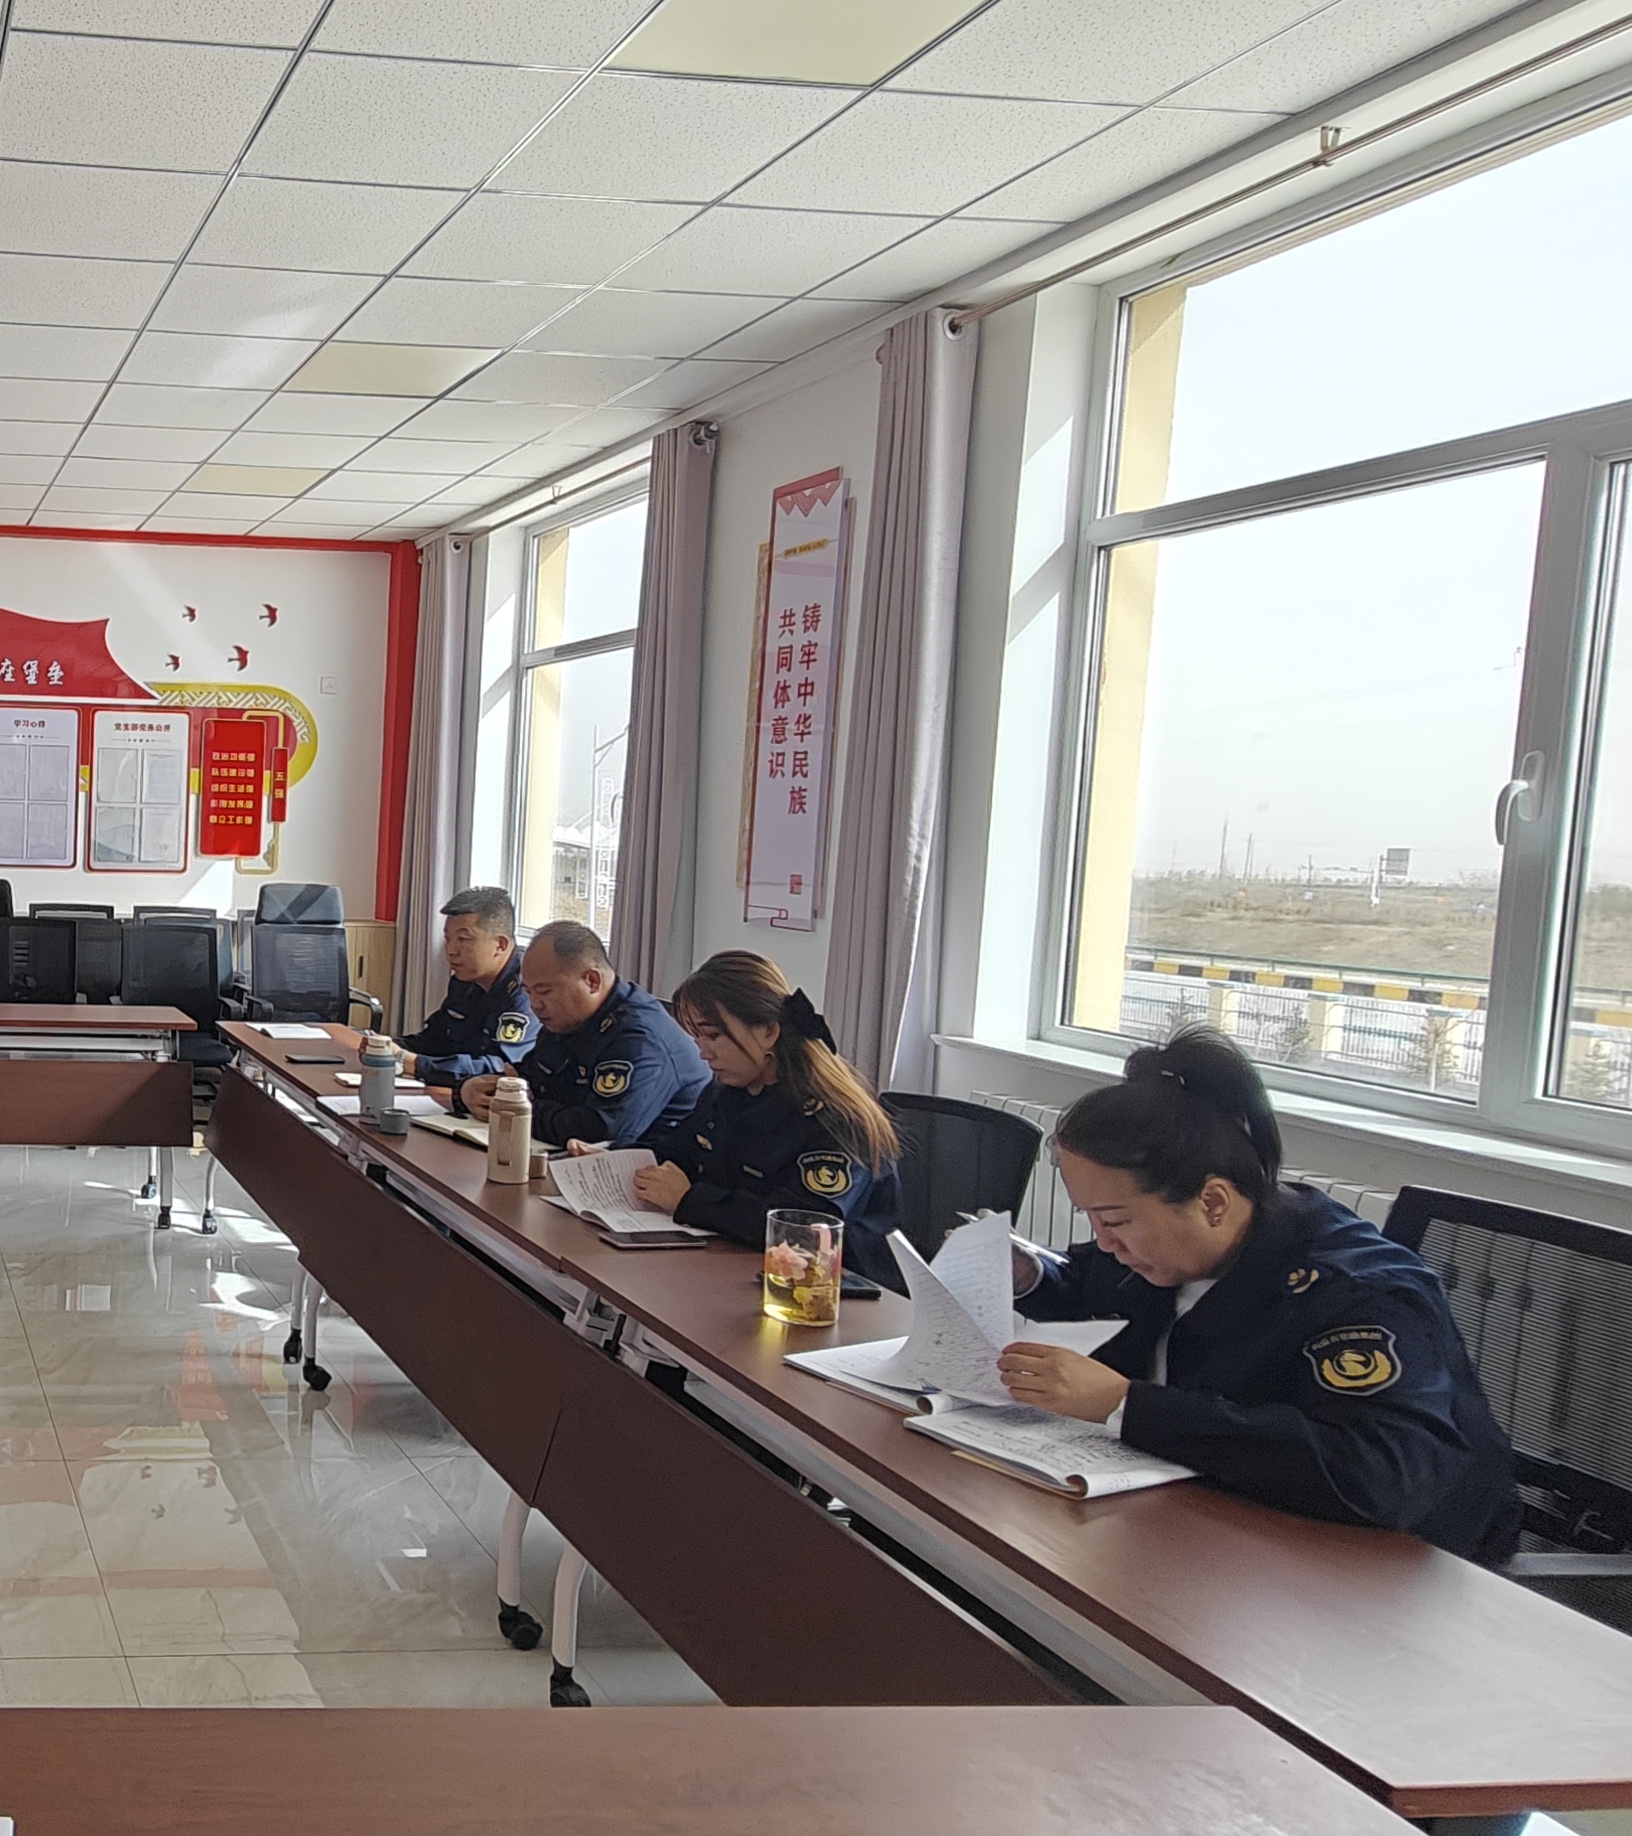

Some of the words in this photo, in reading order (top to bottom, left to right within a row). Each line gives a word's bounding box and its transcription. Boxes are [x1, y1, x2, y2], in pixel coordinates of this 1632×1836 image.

[14, 719, 46, 728] 学习心得
[769, 608, 796, 779] 共同体意识
[788, 603, 821, 815] 铸牢中华民族
